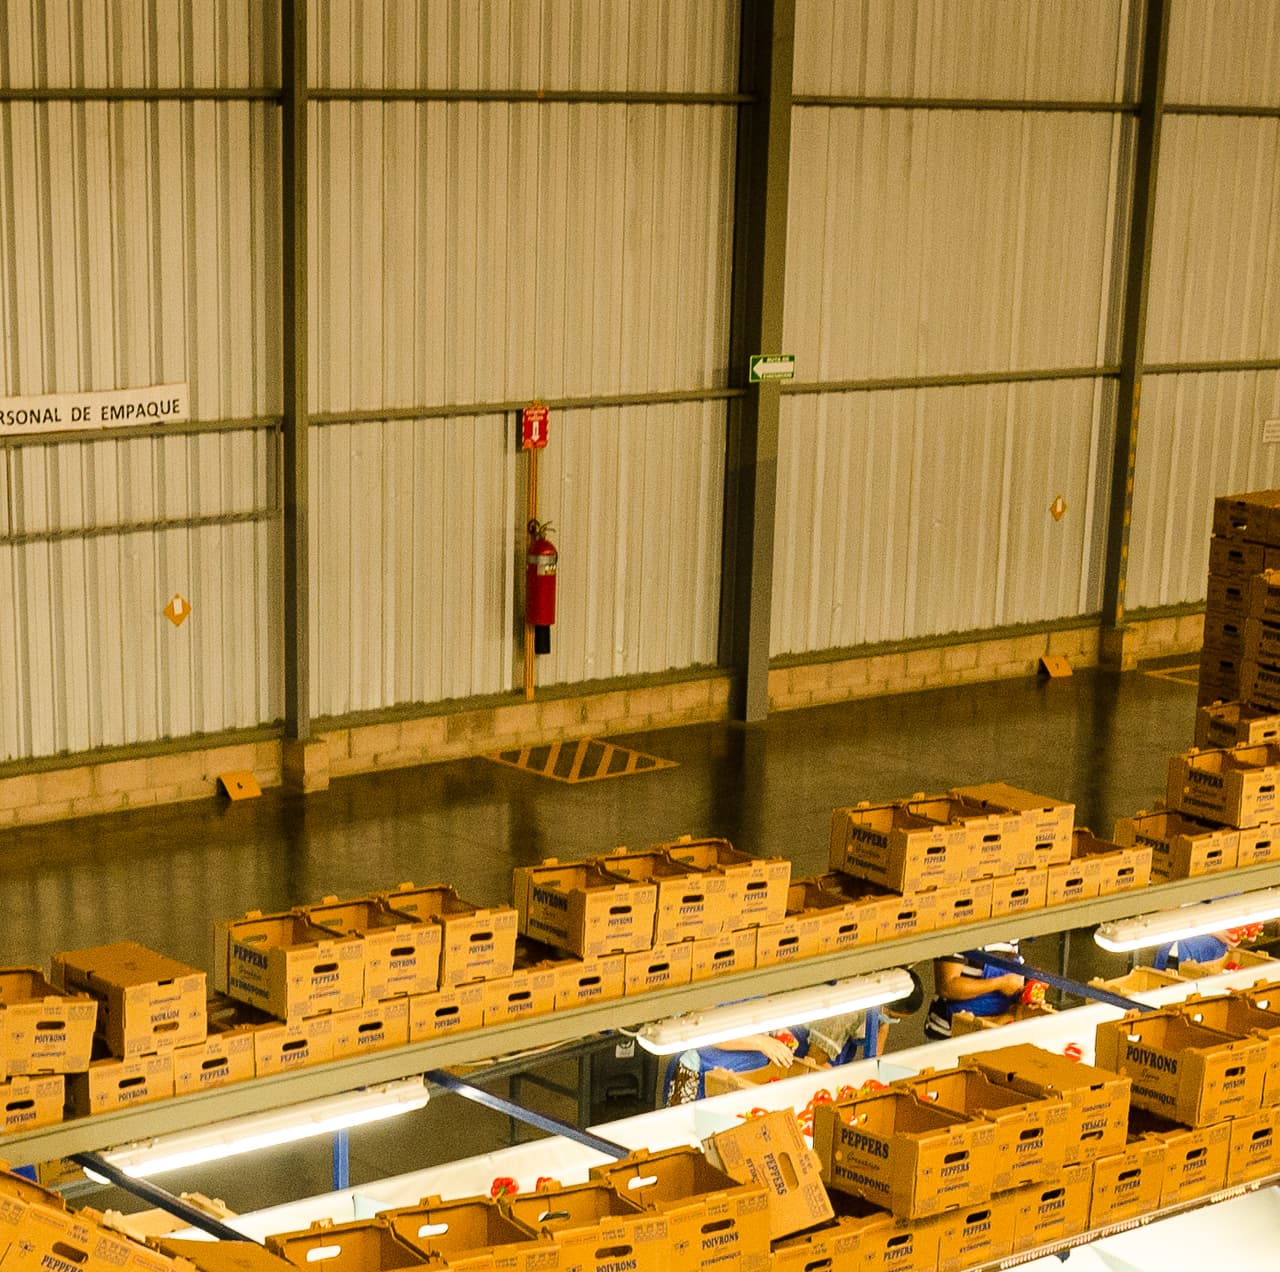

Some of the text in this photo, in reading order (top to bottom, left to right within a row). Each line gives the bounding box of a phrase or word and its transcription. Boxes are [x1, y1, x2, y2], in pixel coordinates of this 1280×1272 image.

[71, 405, 92, 422] DE
[100, 398, 181, 422] EMPAQUE
[852, 829, 888, 849] PEPPERS
[311, 973, 339, 985] PEPPERS
[34, 1034, 66, 1044] POIVRONS
[280, 1050, 309, 1063] PEPPERS
[1126, 1046, 1178, 1074] POIVRONS
[200, 1068, 229, 1081] PEPPERS
[1131, 1086, 1176, 1106] DROPONIQUE
[6, 1112, 36, 1125] POIVRONS
[840, 1127, 889, 1158] PEPPERS
[1015, 1139, 1044, 1152] PEPPERS
[764, 1153, 787, 1195] PEPPERS
[940, 1163, 970, 1177] PEPPERS
[834, 1165, 890, 1194] HYDROPONIC
[1038, 1200, 1065, 1215] PEPPERS
[962, 1221, 991, 1237] PEPPERS
[702, 1232, 738, 1249] POIVRONS
[883, 1246, 913, 1261] PEPPERS
